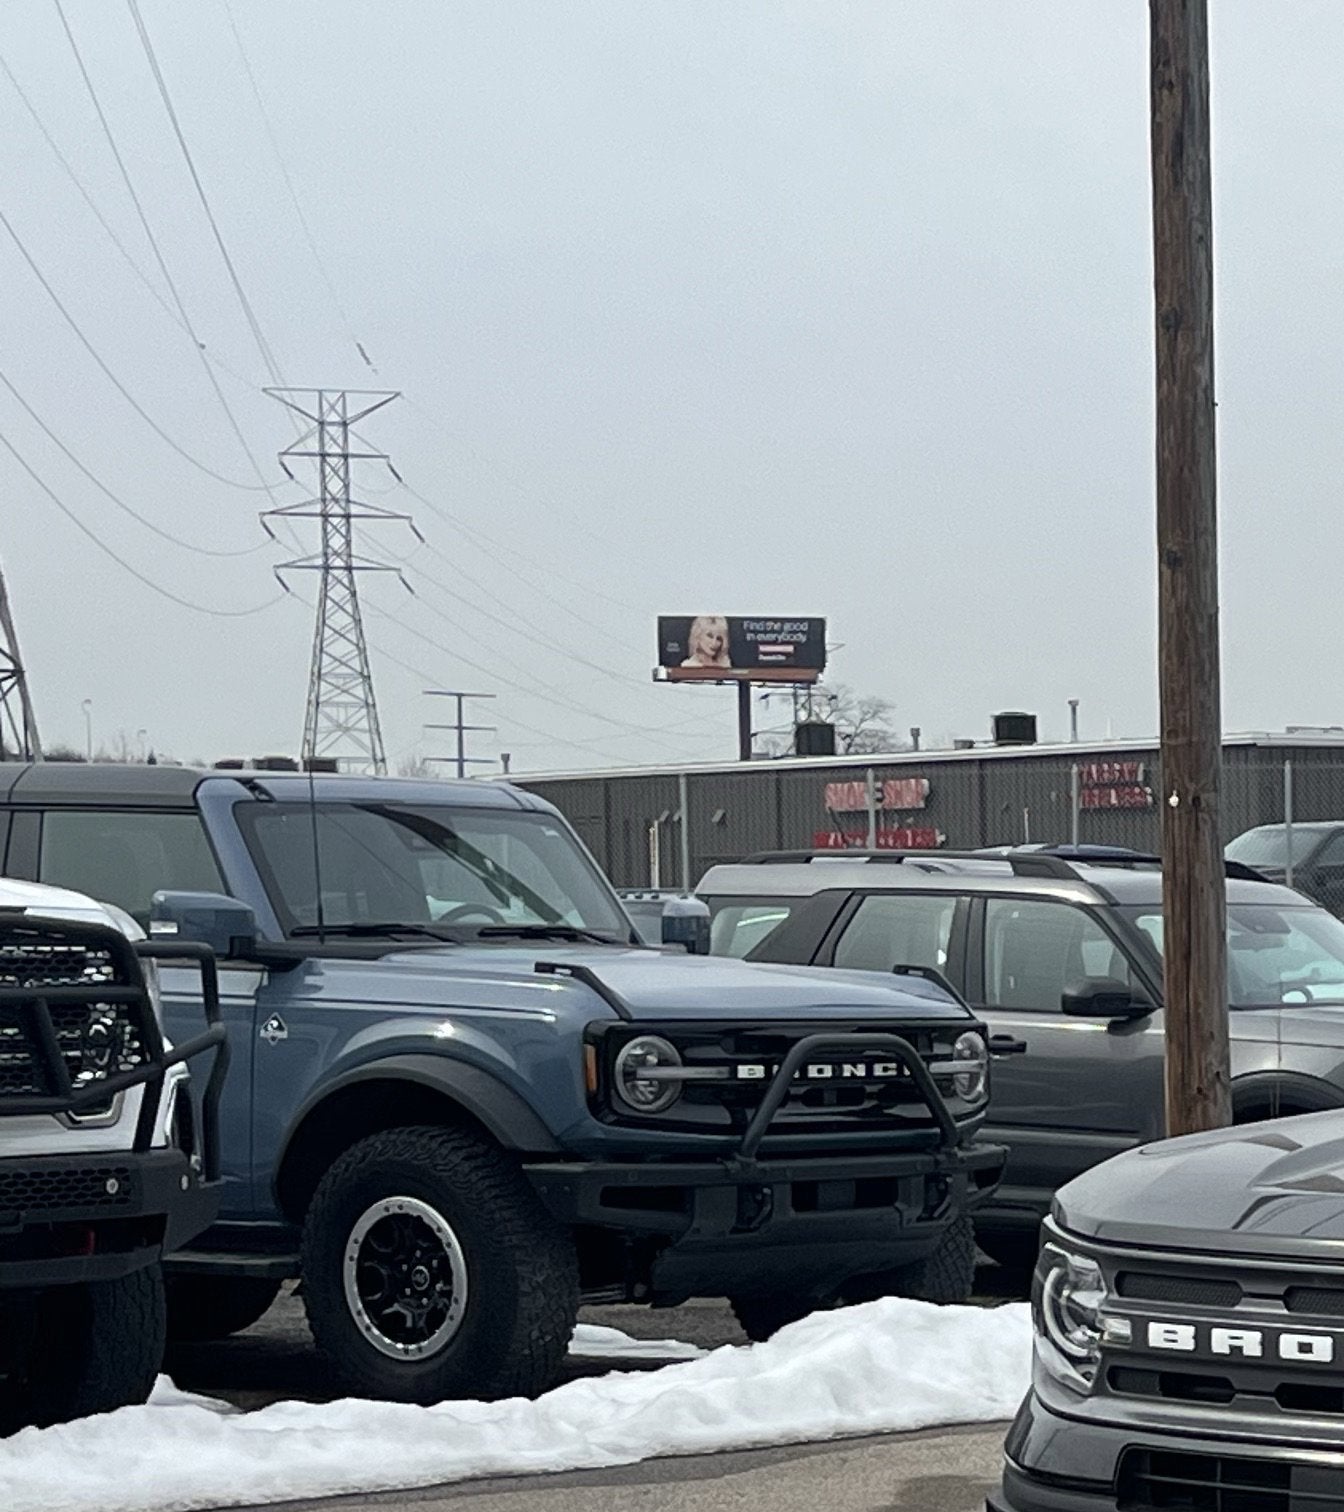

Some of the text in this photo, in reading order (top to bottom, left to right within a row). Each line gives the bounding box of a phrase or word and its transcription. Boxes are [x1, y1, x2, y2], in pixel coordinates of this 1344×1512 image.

[743, 620, 809, 633] Find the good
[737, 1063, 911, 1079] BONC
